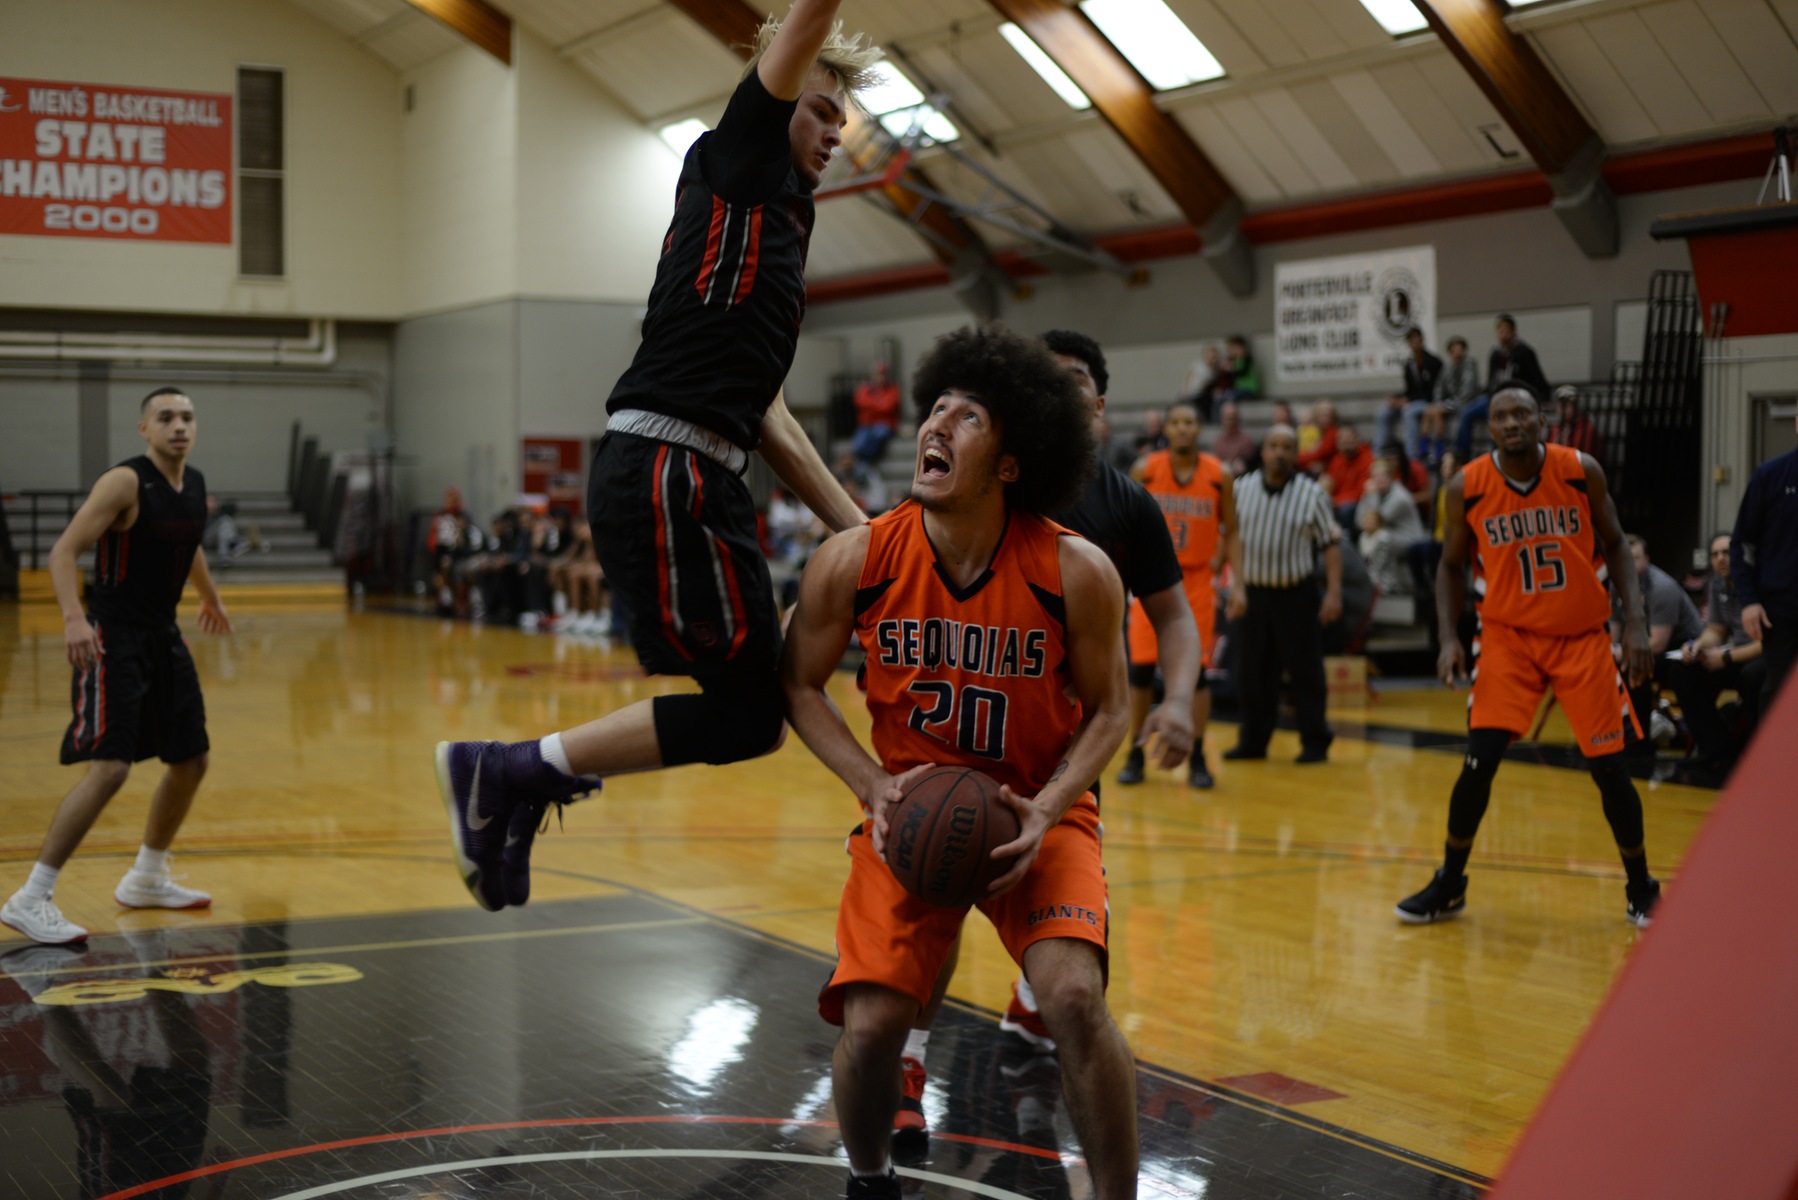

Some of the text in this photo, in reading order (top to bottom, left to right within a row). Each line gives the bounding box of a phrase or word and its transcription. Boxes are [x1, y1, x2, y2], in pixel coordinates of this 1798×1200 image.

[28, 87, 88, 117] MEN'S
[93, 92, 222, 127] BASKETBALL
[35, 118, 166, 163] STATE
[0, 159, 226, 209] HAMPIONS
[43, 203, 159, 234] 2000
[1483, 505, 1581, 546] SEQUOIAS
[1517, 541, 1566, 594] 15
[877, 617, 1047, 678] SEQUOIAS
[907, 680, 1008, 761] 20
[930, 804, 978, 893] Wilson
[1028, 904, 1098, 926] GIANTS
